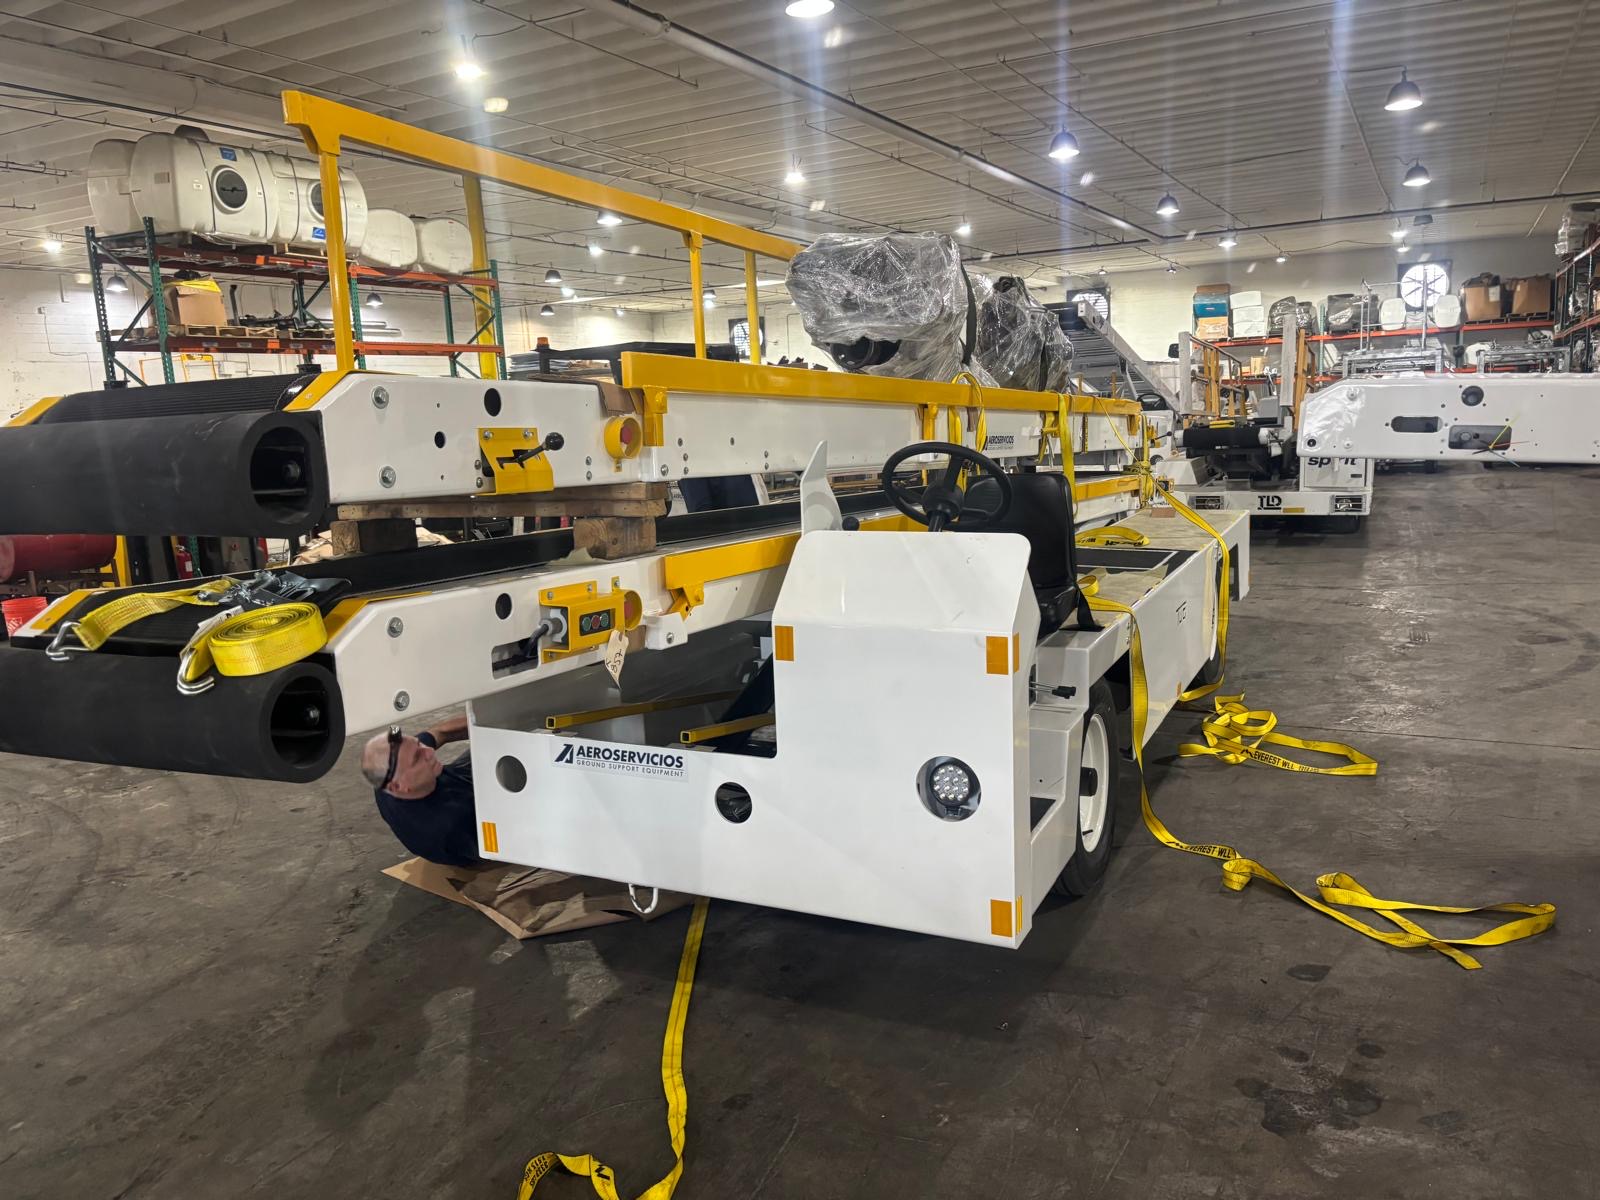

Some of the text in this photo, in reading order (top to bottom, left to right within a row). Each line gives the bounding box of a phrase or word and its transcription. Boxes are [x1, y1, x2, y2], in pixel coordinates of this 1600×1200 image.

[1308, 456, 1357, 468] sprit
[1258, 495, 1282, 508] TLD
[576, 745, 684, 769] AEROSERVICIOS
[1253, 750, 1281, 766] EVEREST
[576, 760, 685, 778] GROUND SUPPORT EQUIPMENT
[1185, 845, 1232, 859] VEREST WLL
